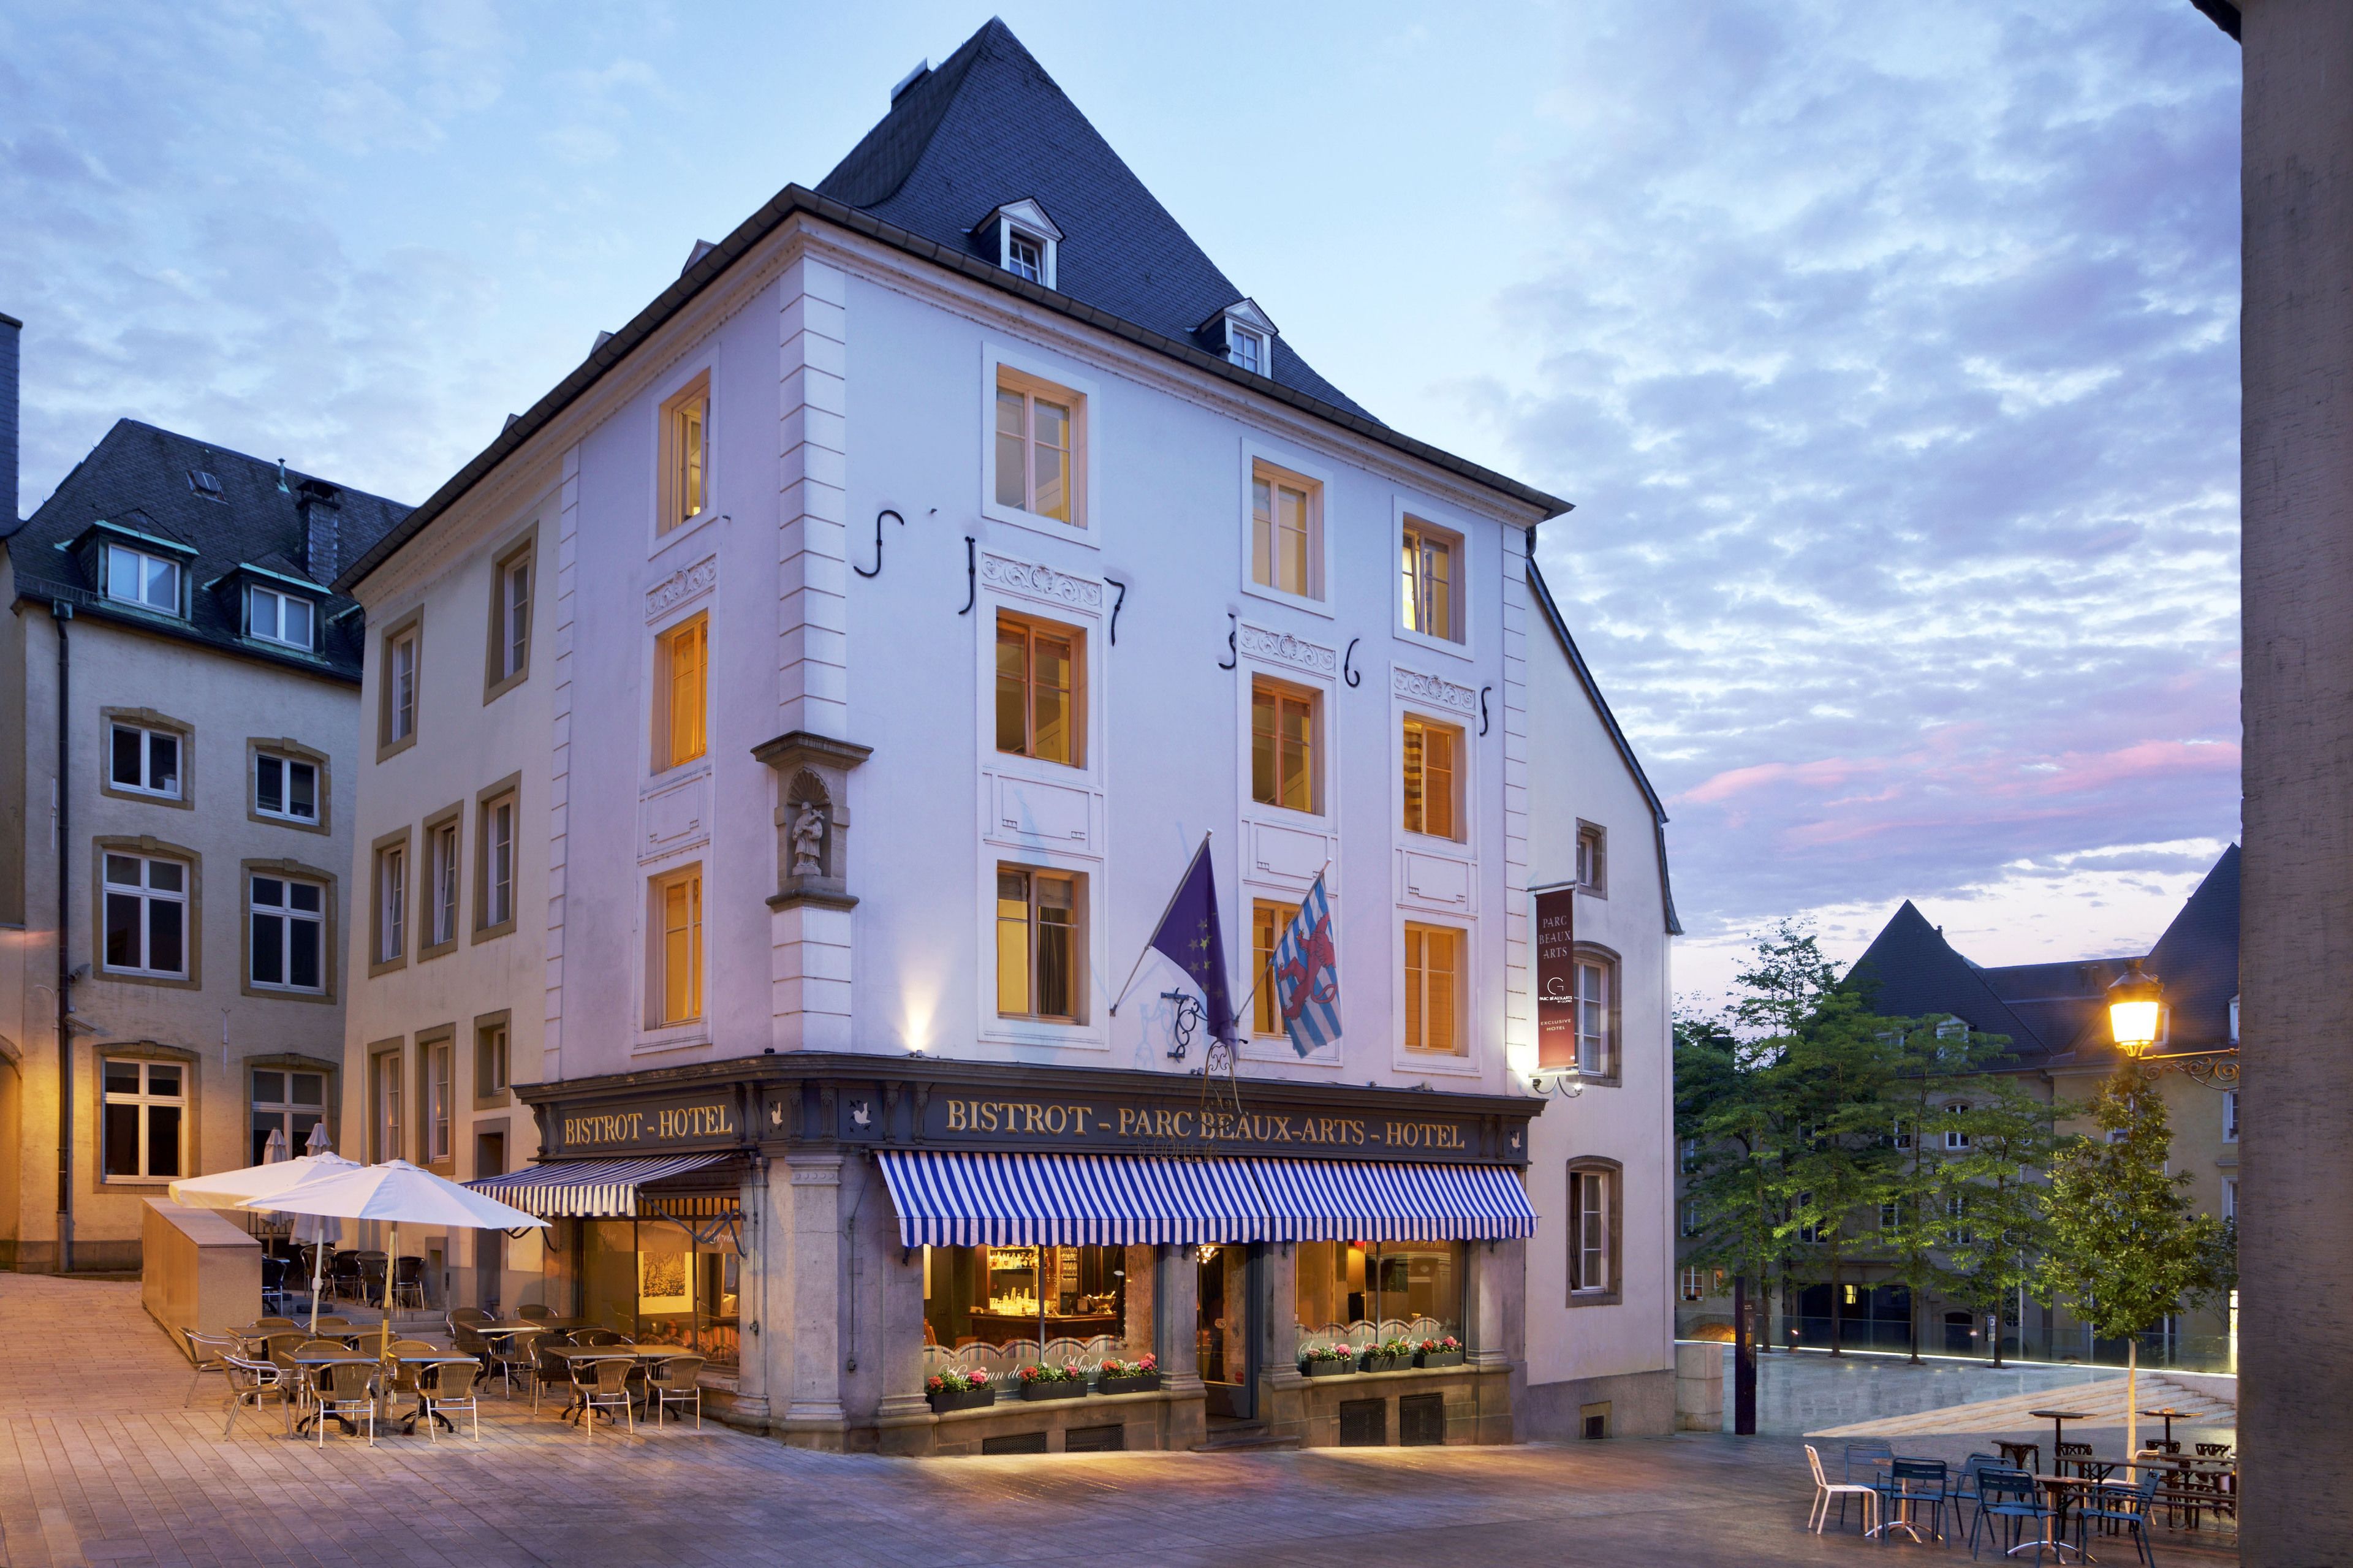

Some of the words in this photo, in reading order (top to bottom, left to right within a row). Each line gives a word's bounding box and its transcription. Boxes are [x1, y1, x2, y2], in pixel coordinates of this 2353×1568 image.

[1543, 915, 1567, 928] PARC
[1539, 930, 1571, 945] BEAUX
[1543, 947, 1567, 960] ARTS
[564, 1113, 642, 1145] BISTROT
[658, 1104, 733, 1139] HOTEL
[946, 1100, 1092, 1136] BISTROT
[1118, 1108, 1192, 1138] PARC
[1385, 1122, 1465, 1150] HOTEL
